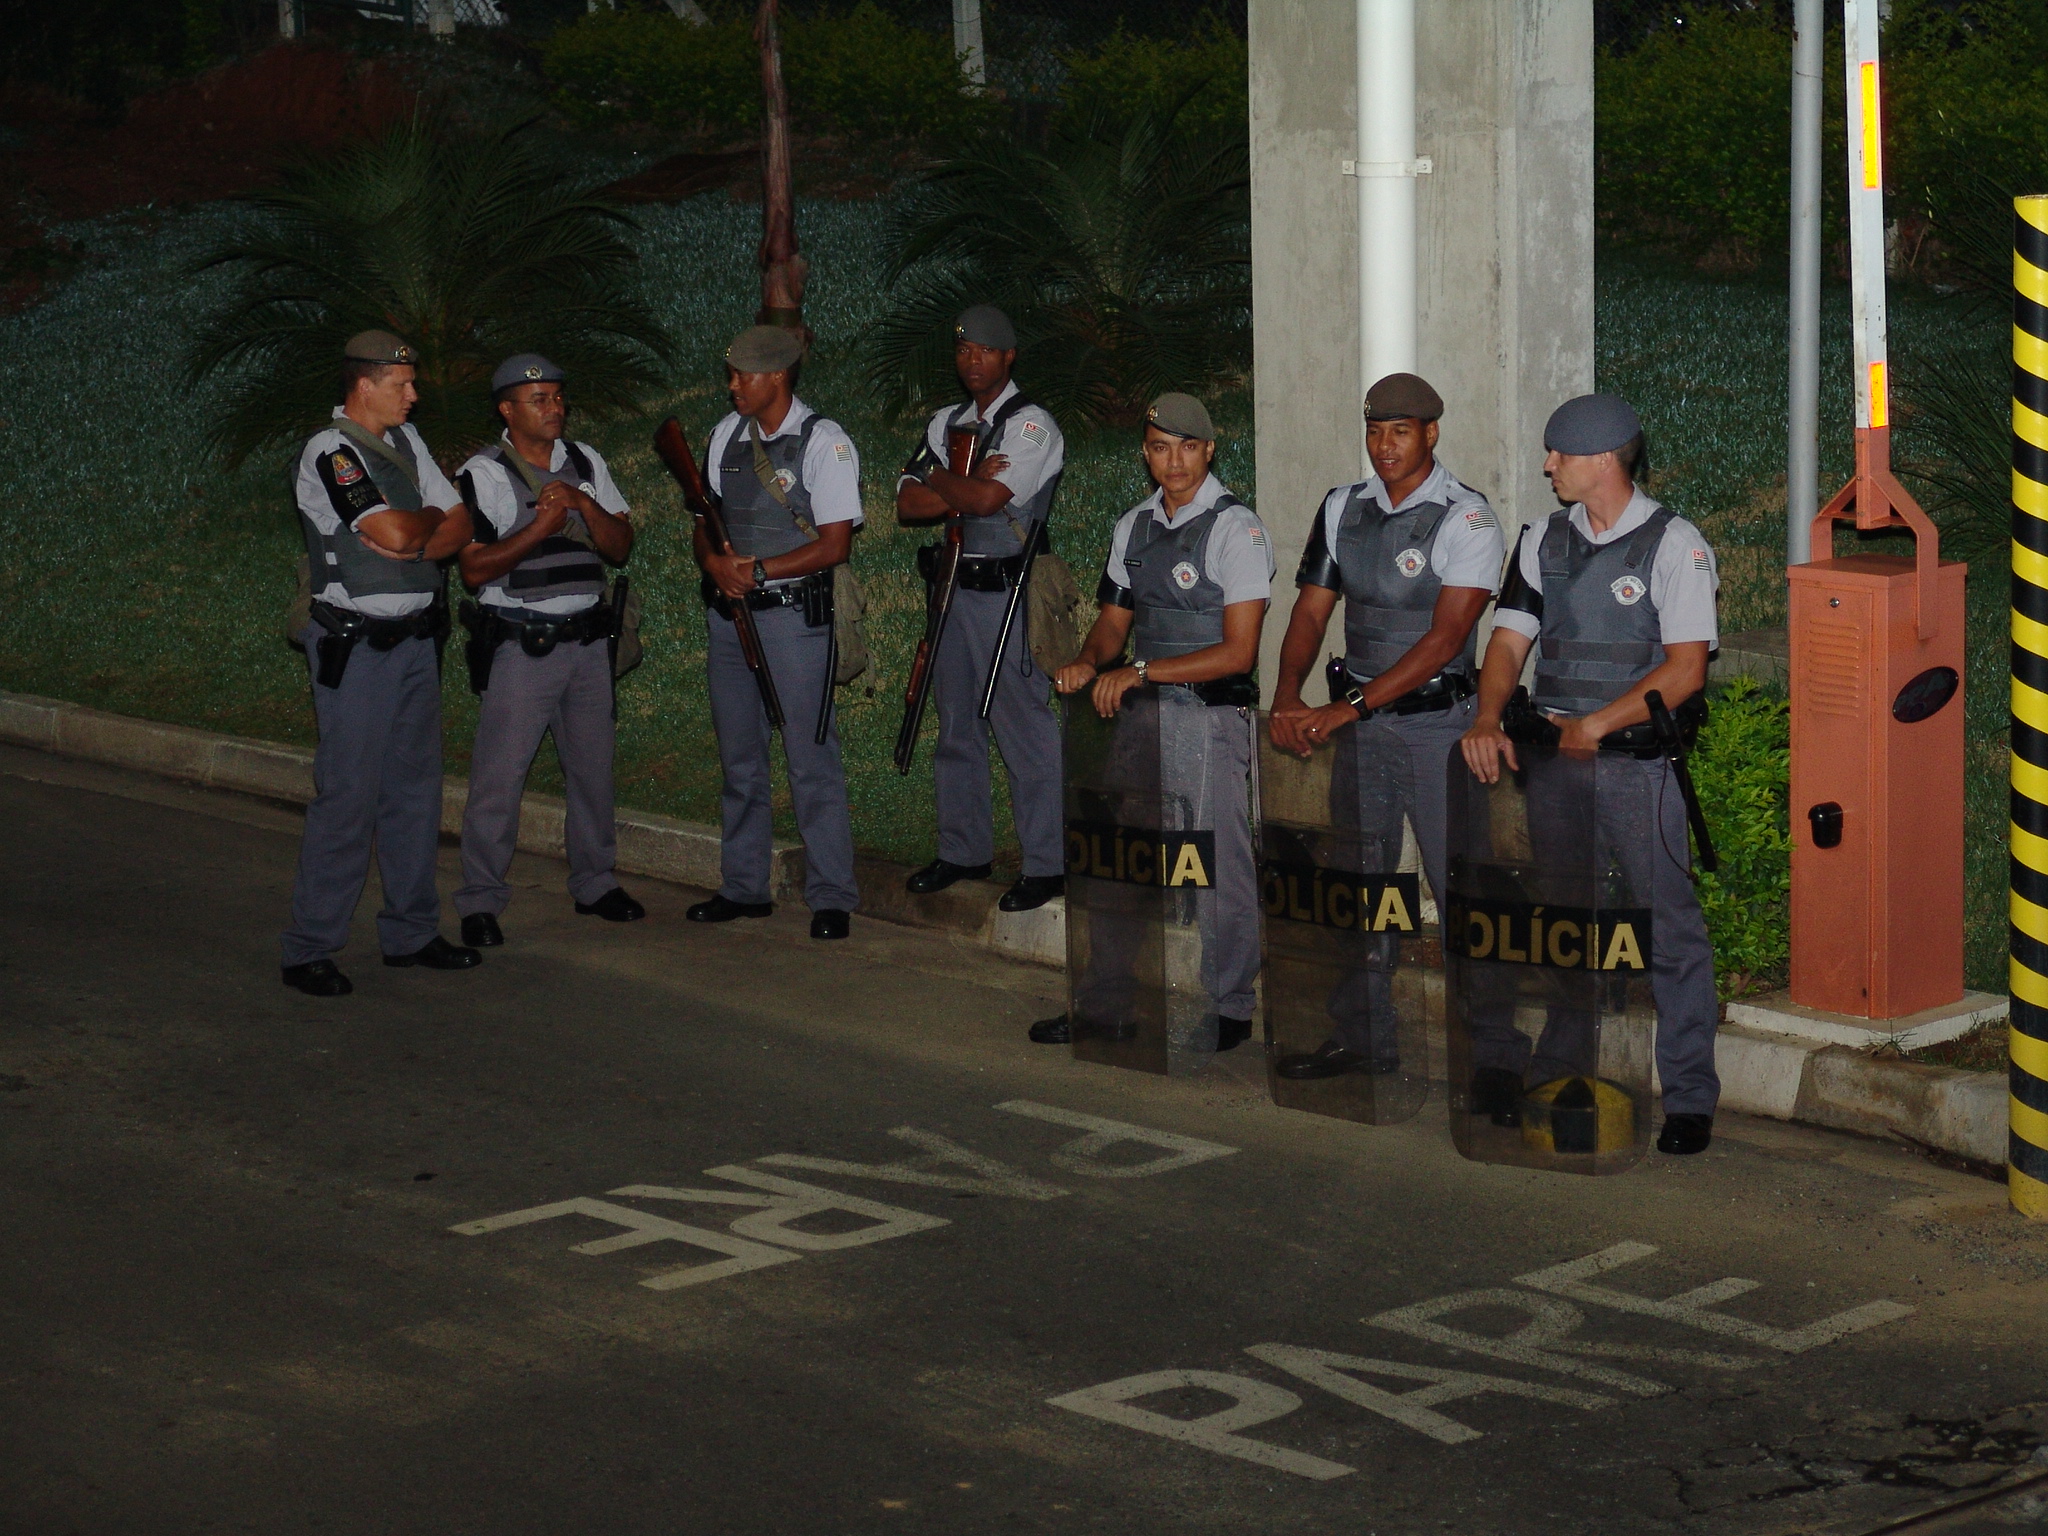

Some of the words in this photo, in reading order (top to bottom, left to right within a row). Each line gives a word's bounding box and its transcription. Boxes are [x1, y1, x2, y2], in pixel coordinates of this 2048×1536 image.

[1064, 827, 1210, 888] OLÍCIA
[1262, 866, 1415, 932] OLÍCIA
[448, 1099, 1240, 1291] PARE
[1047, 1240, 1915, 1481] PARE
